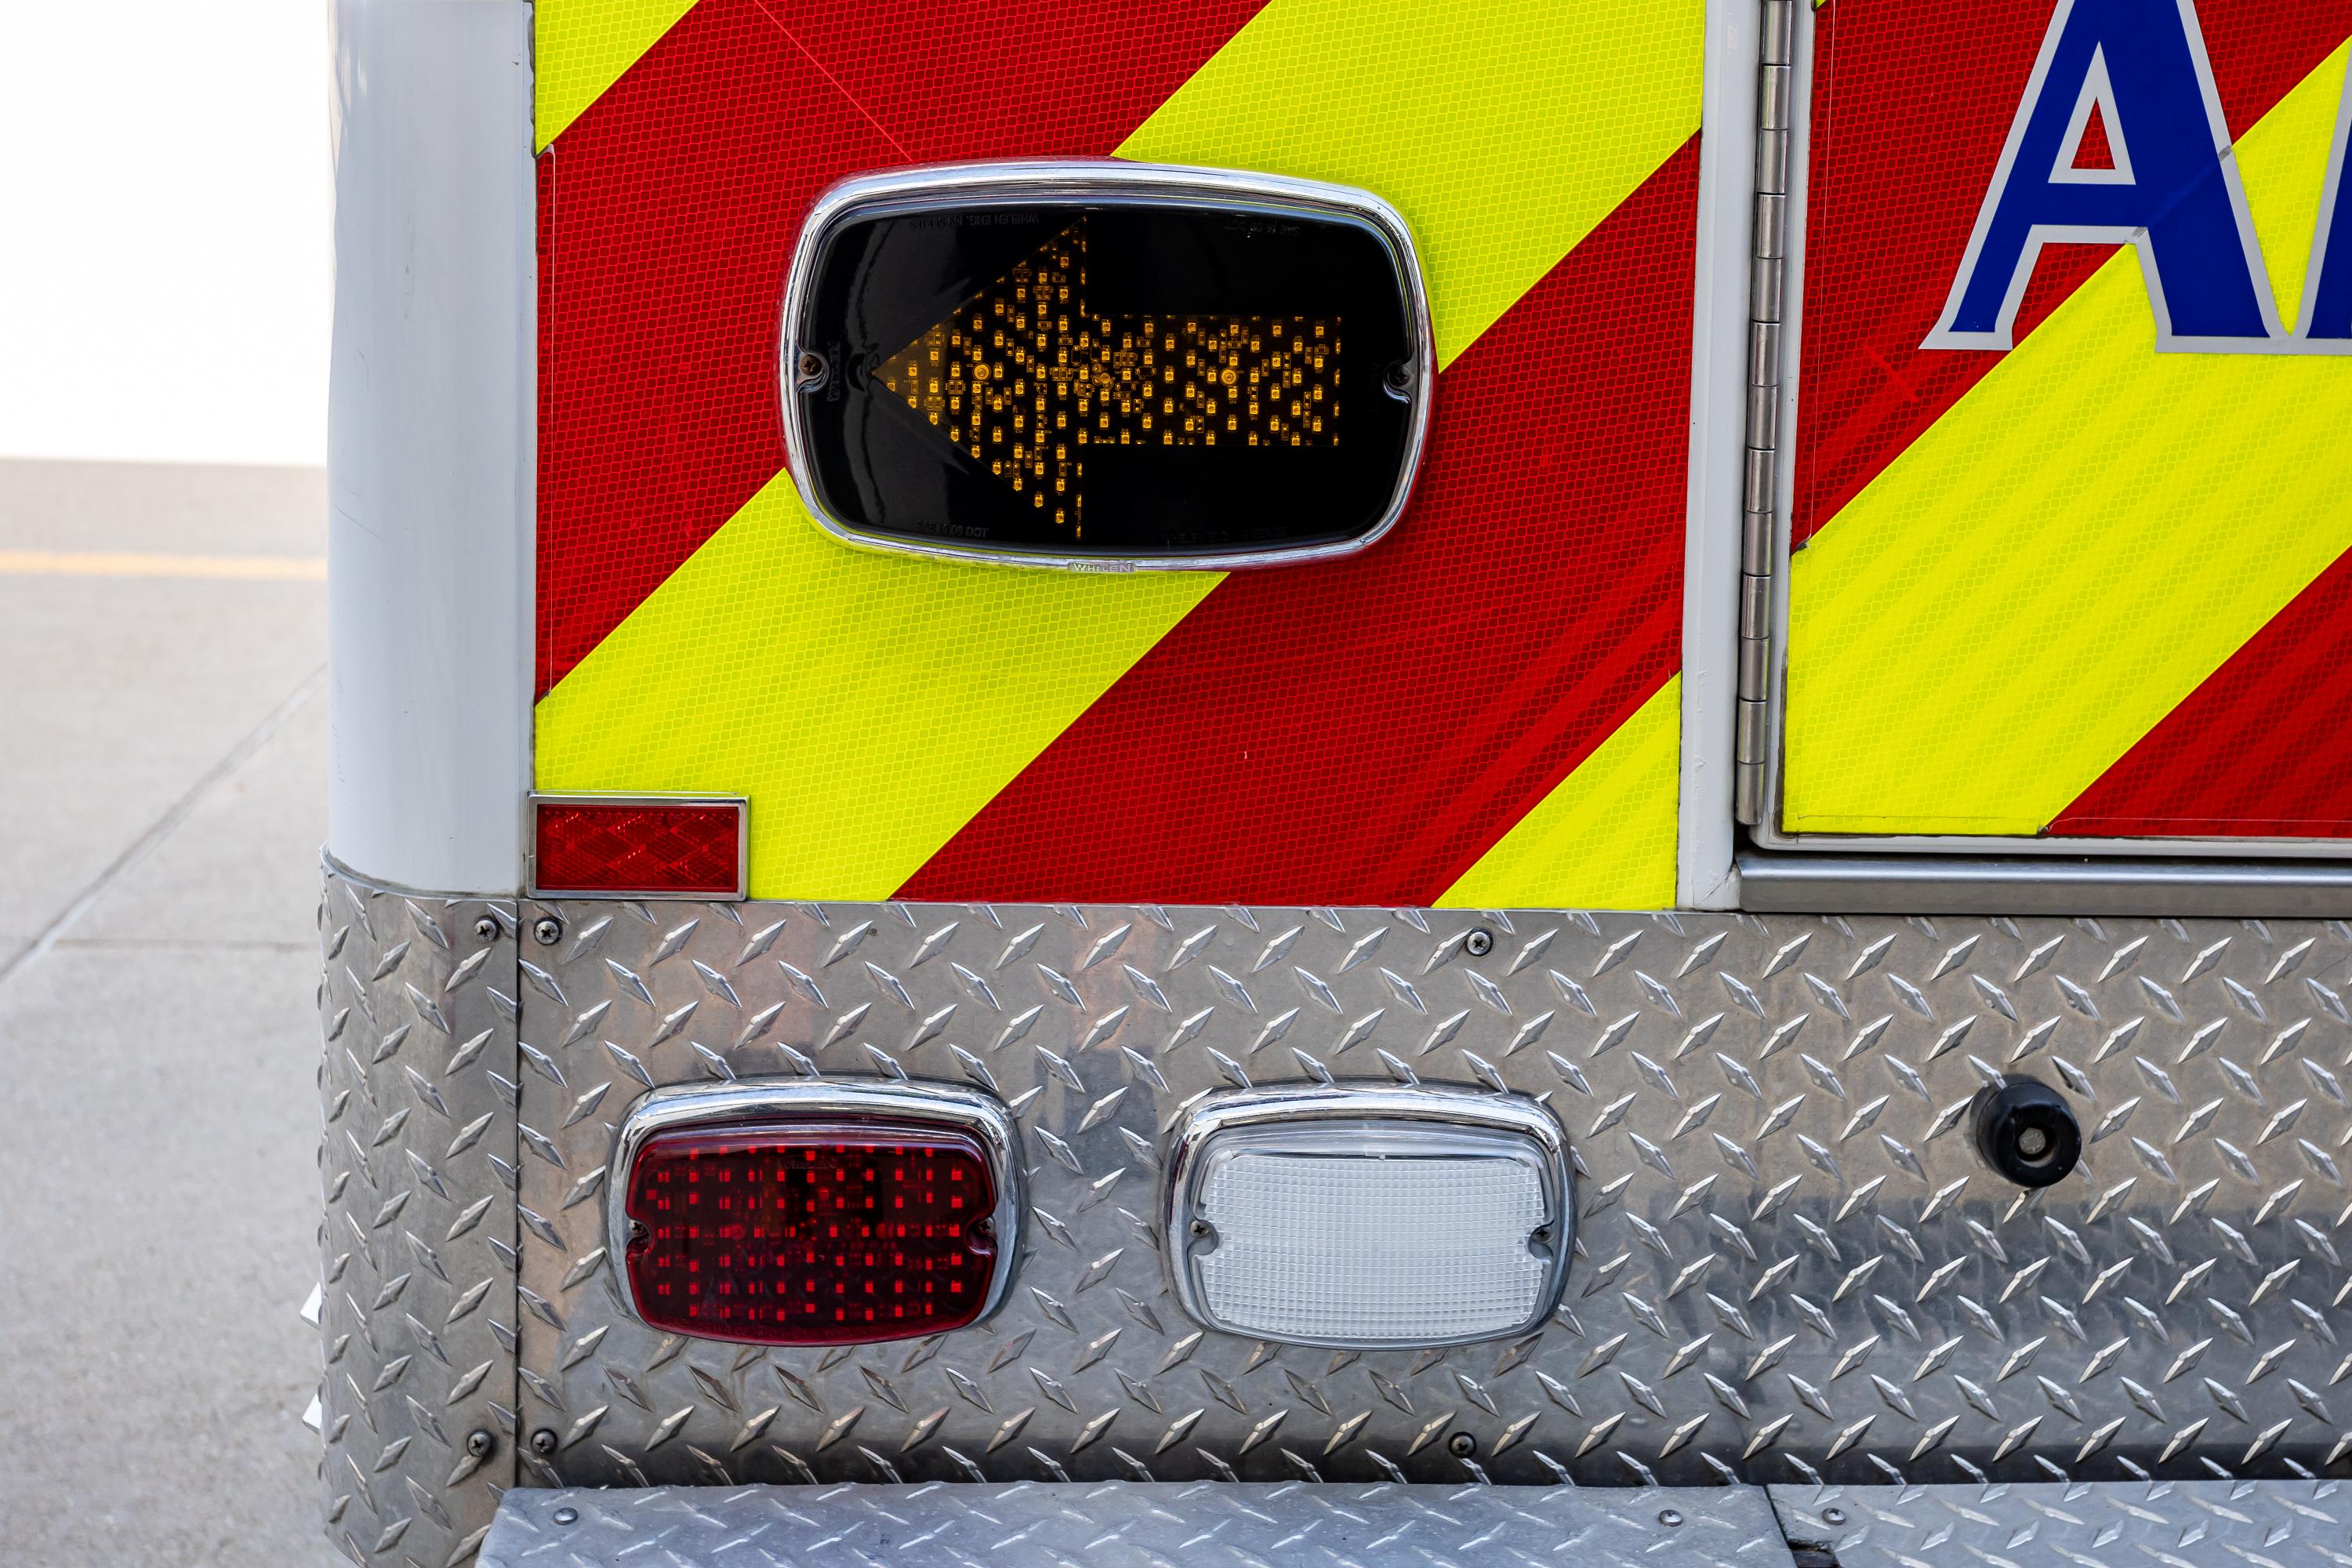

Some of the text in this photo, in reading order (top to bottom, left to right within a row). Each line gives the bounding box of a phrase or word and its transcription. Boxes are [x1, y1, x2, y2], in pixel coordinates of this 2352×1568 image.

[1918, 0, 2352, 355] A
[965, 526, 989, 539] DOT
[1073, 563, 1132, 572] WHELEN
